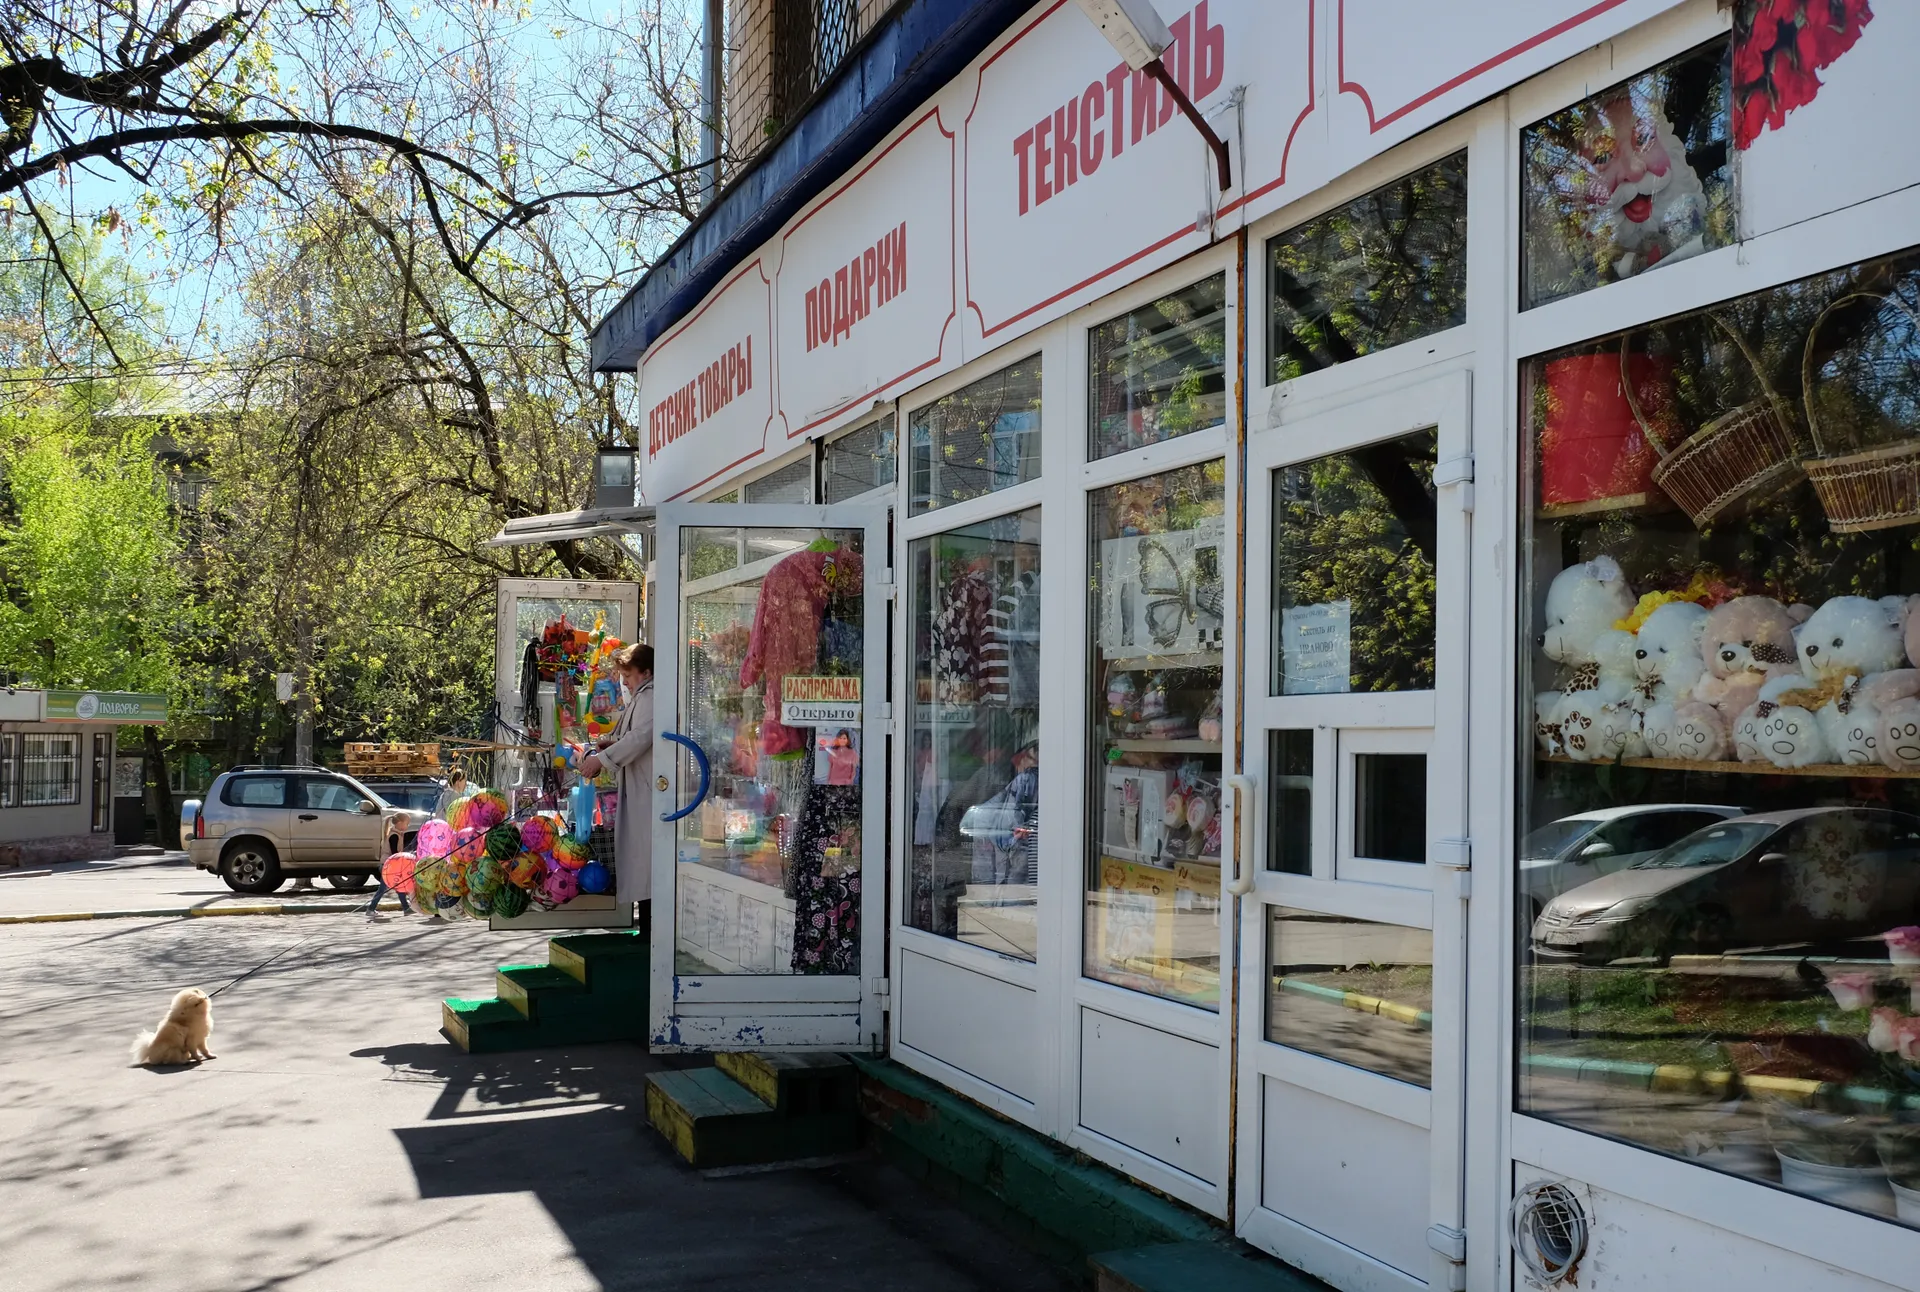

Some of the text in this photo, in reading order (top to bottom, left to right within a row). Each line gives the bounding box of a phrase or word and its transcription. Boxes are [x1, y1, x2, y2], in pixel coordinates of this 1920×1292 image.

[1014, 0, 1224, 217] ТЕКСТИЛЬ
[805, 221, 906, 353] ПОДАРКИ
[649, 334, 752, 464] ДЕТСКИЕ ТОВАРЫ
[99, 702, 140, 714] ПОДВОРЬЕ
[786, 678, 858, 700] РАСПРОДАЖА
[788, 705, 855, 720] Открыто
